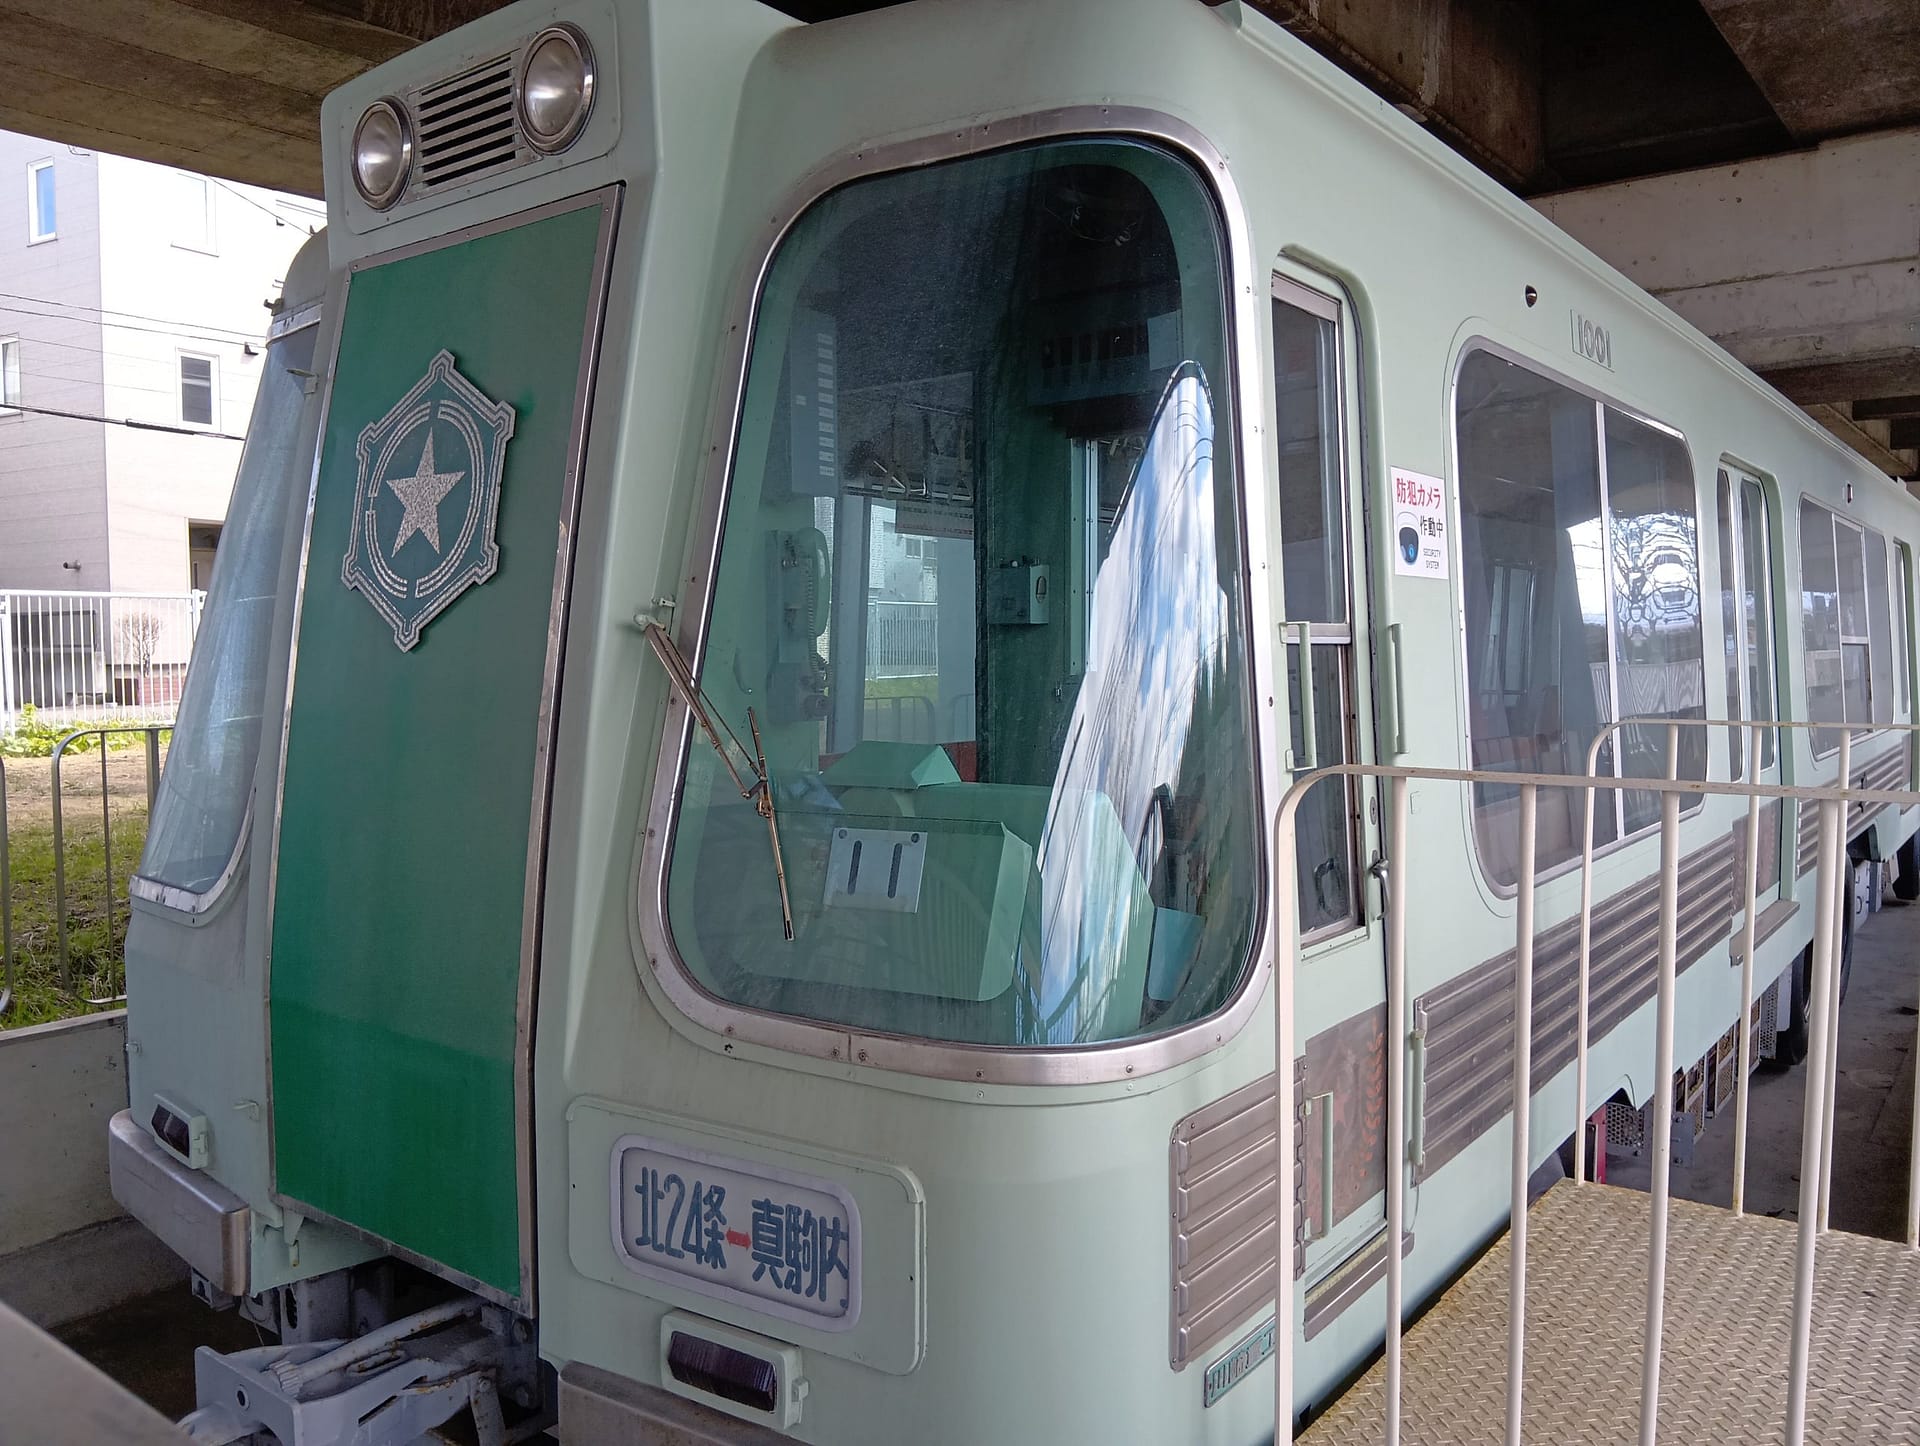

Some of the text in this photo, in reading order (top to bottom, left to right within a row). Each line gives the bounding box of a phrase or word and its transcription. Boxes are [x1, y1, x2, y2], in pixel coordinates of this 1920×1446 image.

[1577, 313, 1611, 369] 1001
[1396, 477, 1441, 510] 防犯カメラ
[1420, 515, 1444, 539] 作動中
